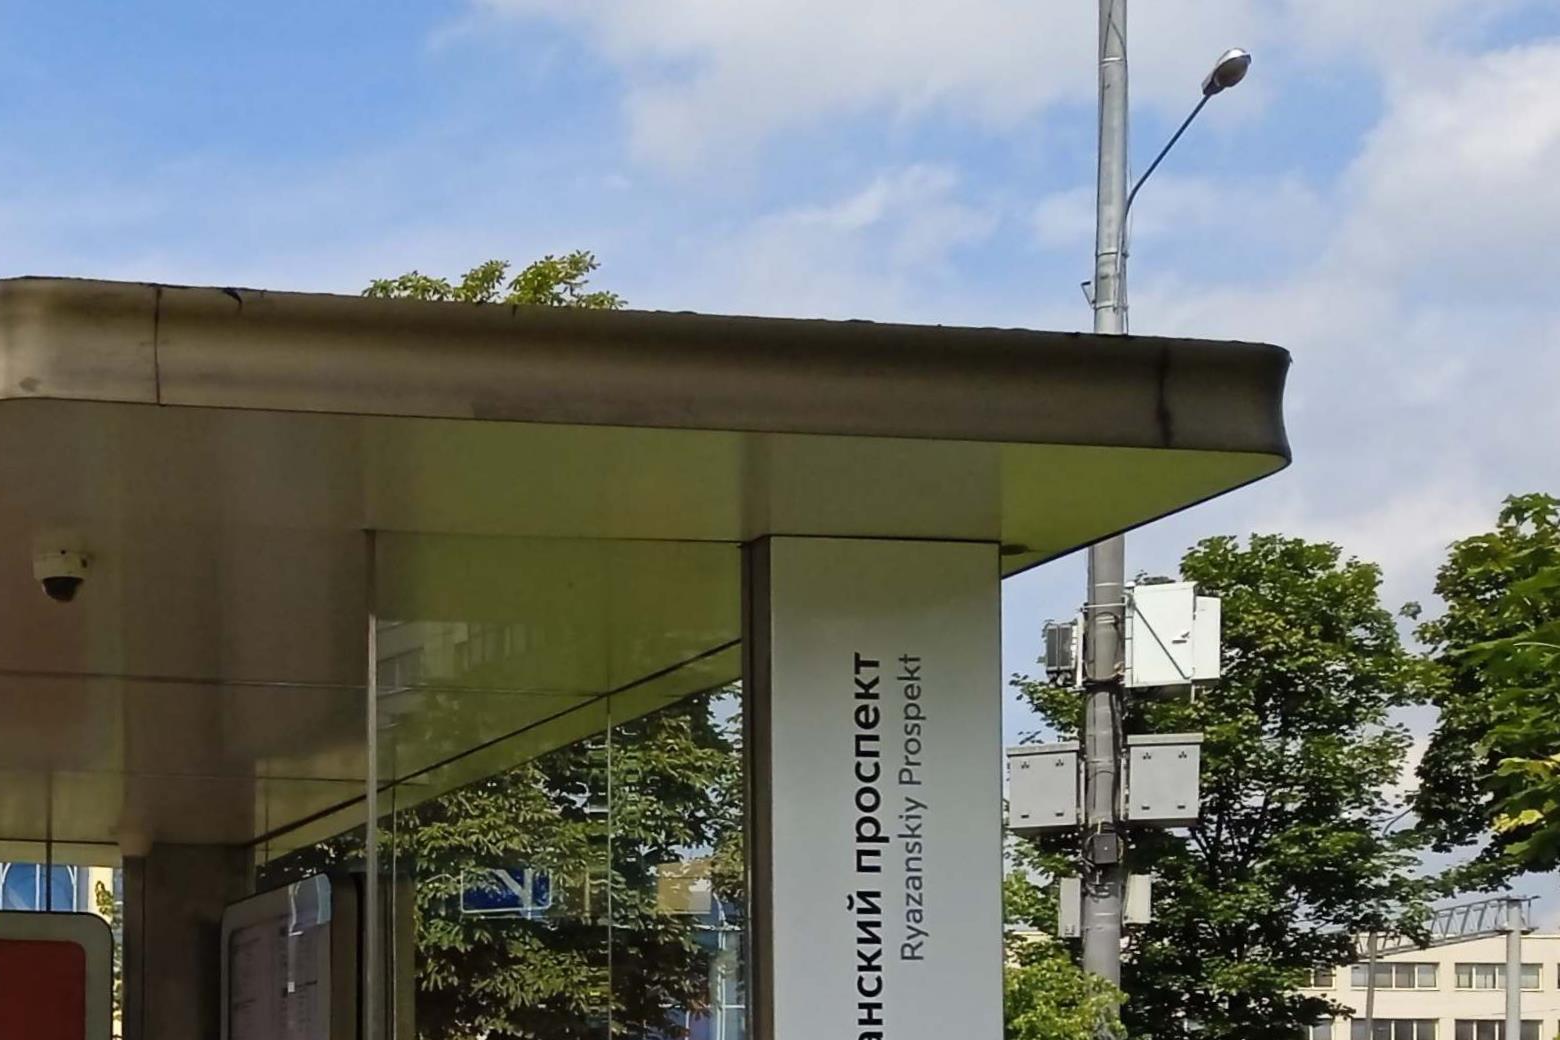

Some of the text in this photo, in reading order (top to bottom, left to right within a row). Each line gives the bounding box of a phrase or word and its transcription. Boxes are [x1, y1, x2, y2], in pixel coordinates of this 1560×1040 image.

[853, 651, 891, 874] проспект
[897, 653, 930, 962] Ryazanskiy Prospekt
